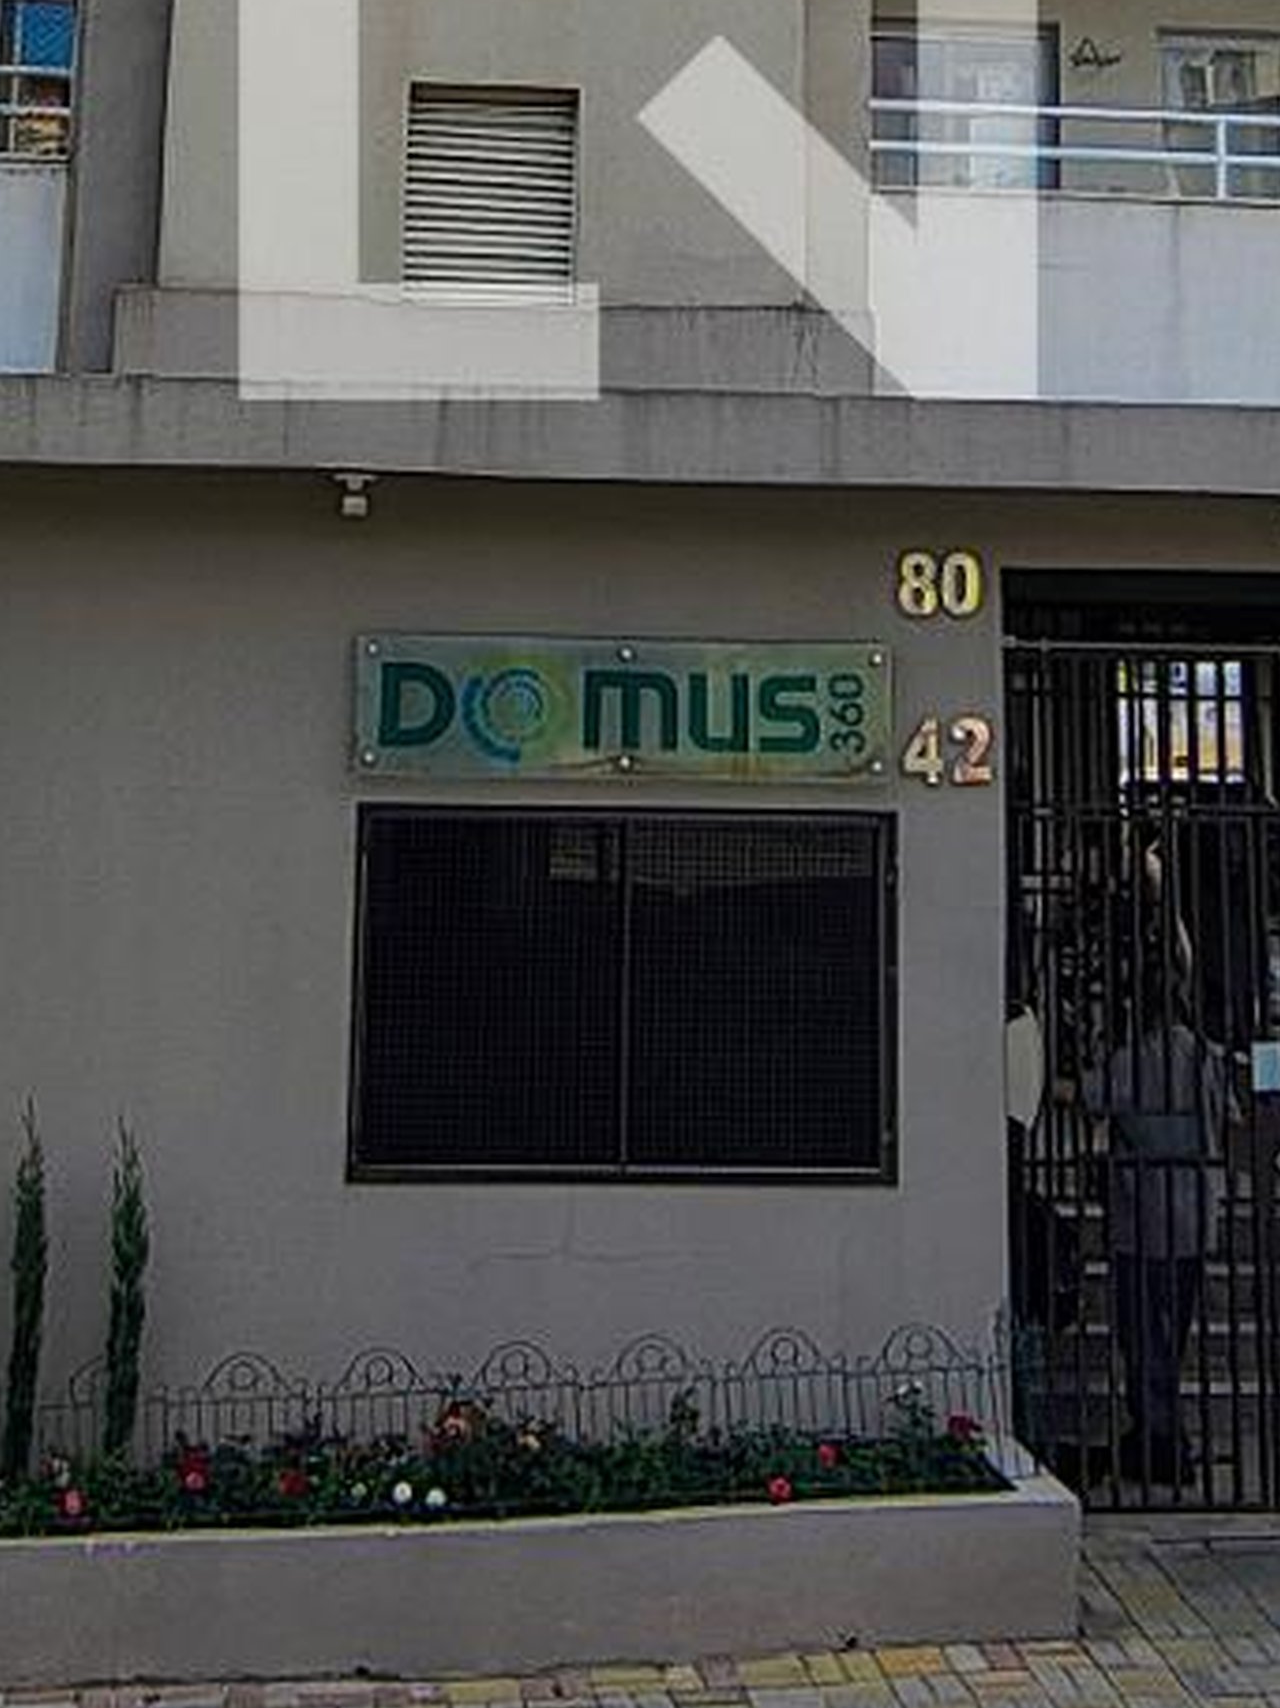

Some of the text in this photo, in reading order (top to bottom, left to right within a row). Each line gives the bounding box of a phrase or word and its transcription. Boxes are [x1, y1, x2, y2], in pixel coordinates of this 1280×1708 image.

[898, 551, 982, 617] 80
[827, 673, 865, 755] 360
[902, 716, 993, 784] 42
